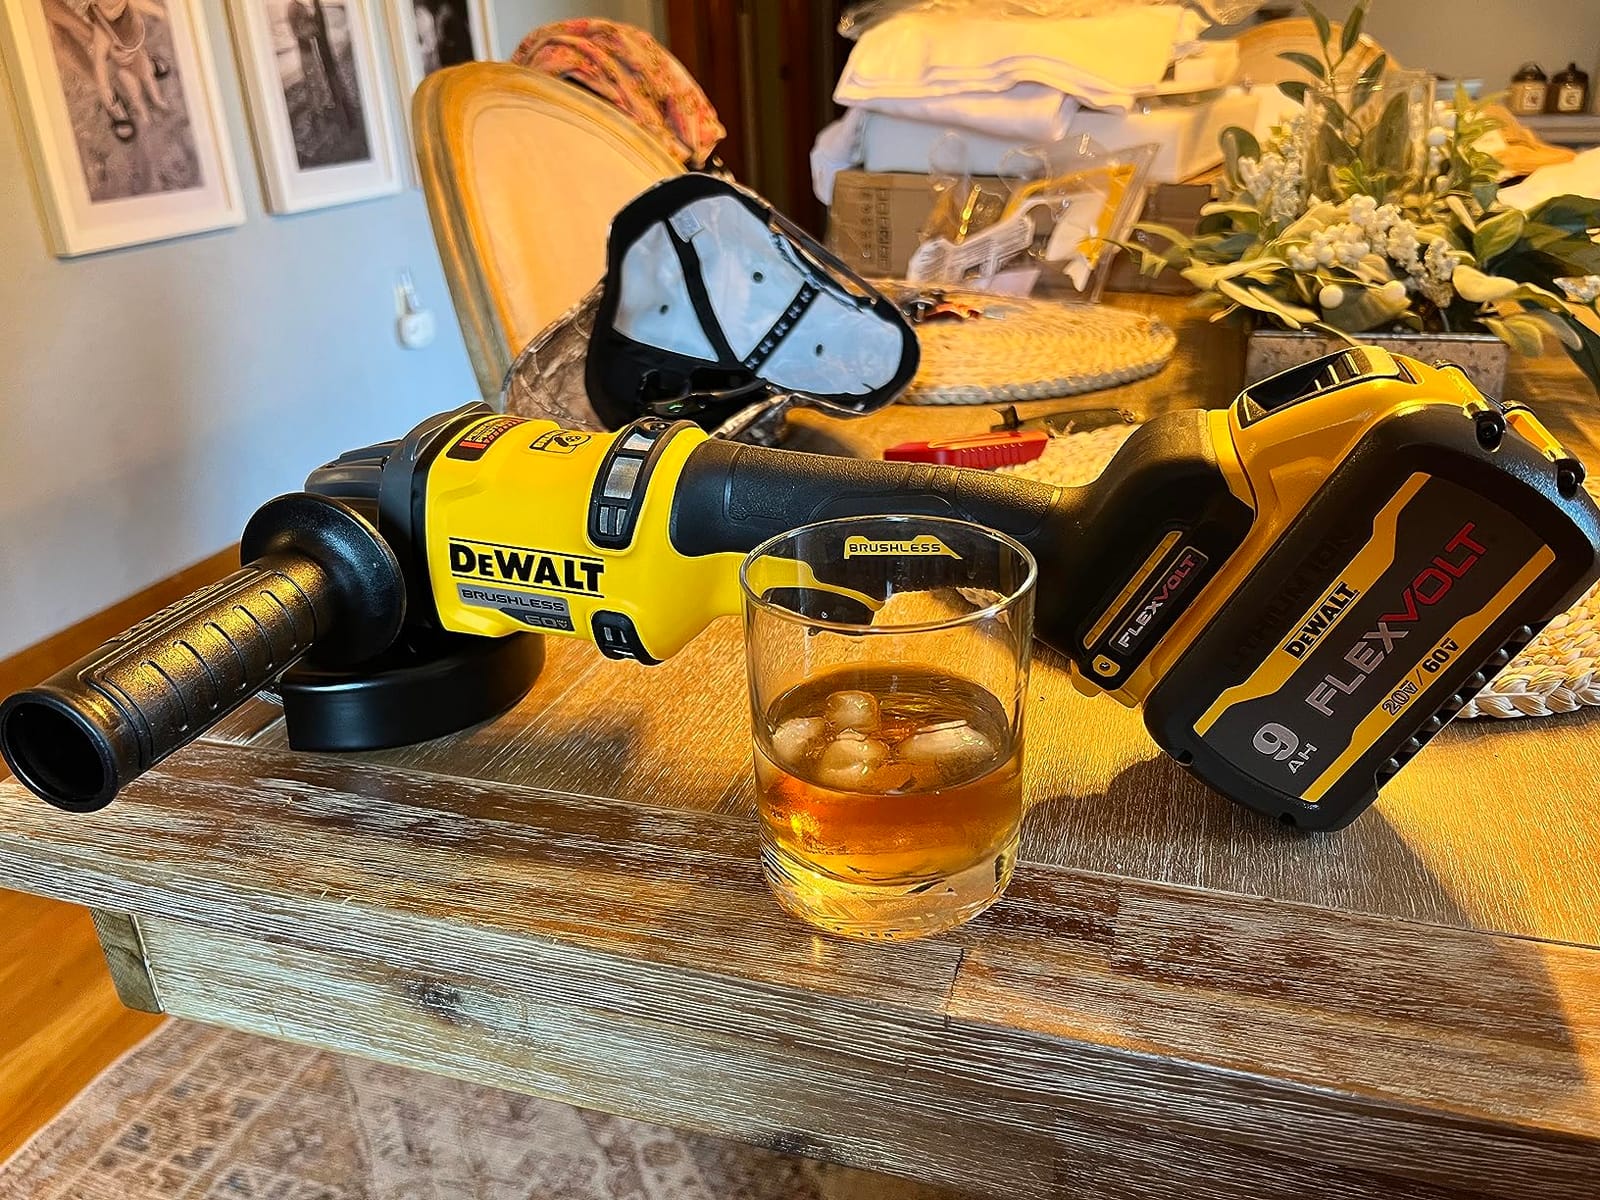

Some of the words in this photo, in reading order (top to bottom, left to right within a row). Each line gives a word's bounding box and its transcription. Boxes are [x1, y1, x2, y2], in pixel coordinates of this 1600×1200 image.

[449, 542, 605, 593] DEWALT
[848, 543, 941, 553] BRUSHLESS
[461, 588, 565, 611] BRUSHLESS
[1117, 554, 1195, 648] FLEXVOLT
[1305, 522, 1487, 717] FLEXVOLT
[1252, 722, 1299, 761] 9
[1287, 742, 1318, 774] AH
